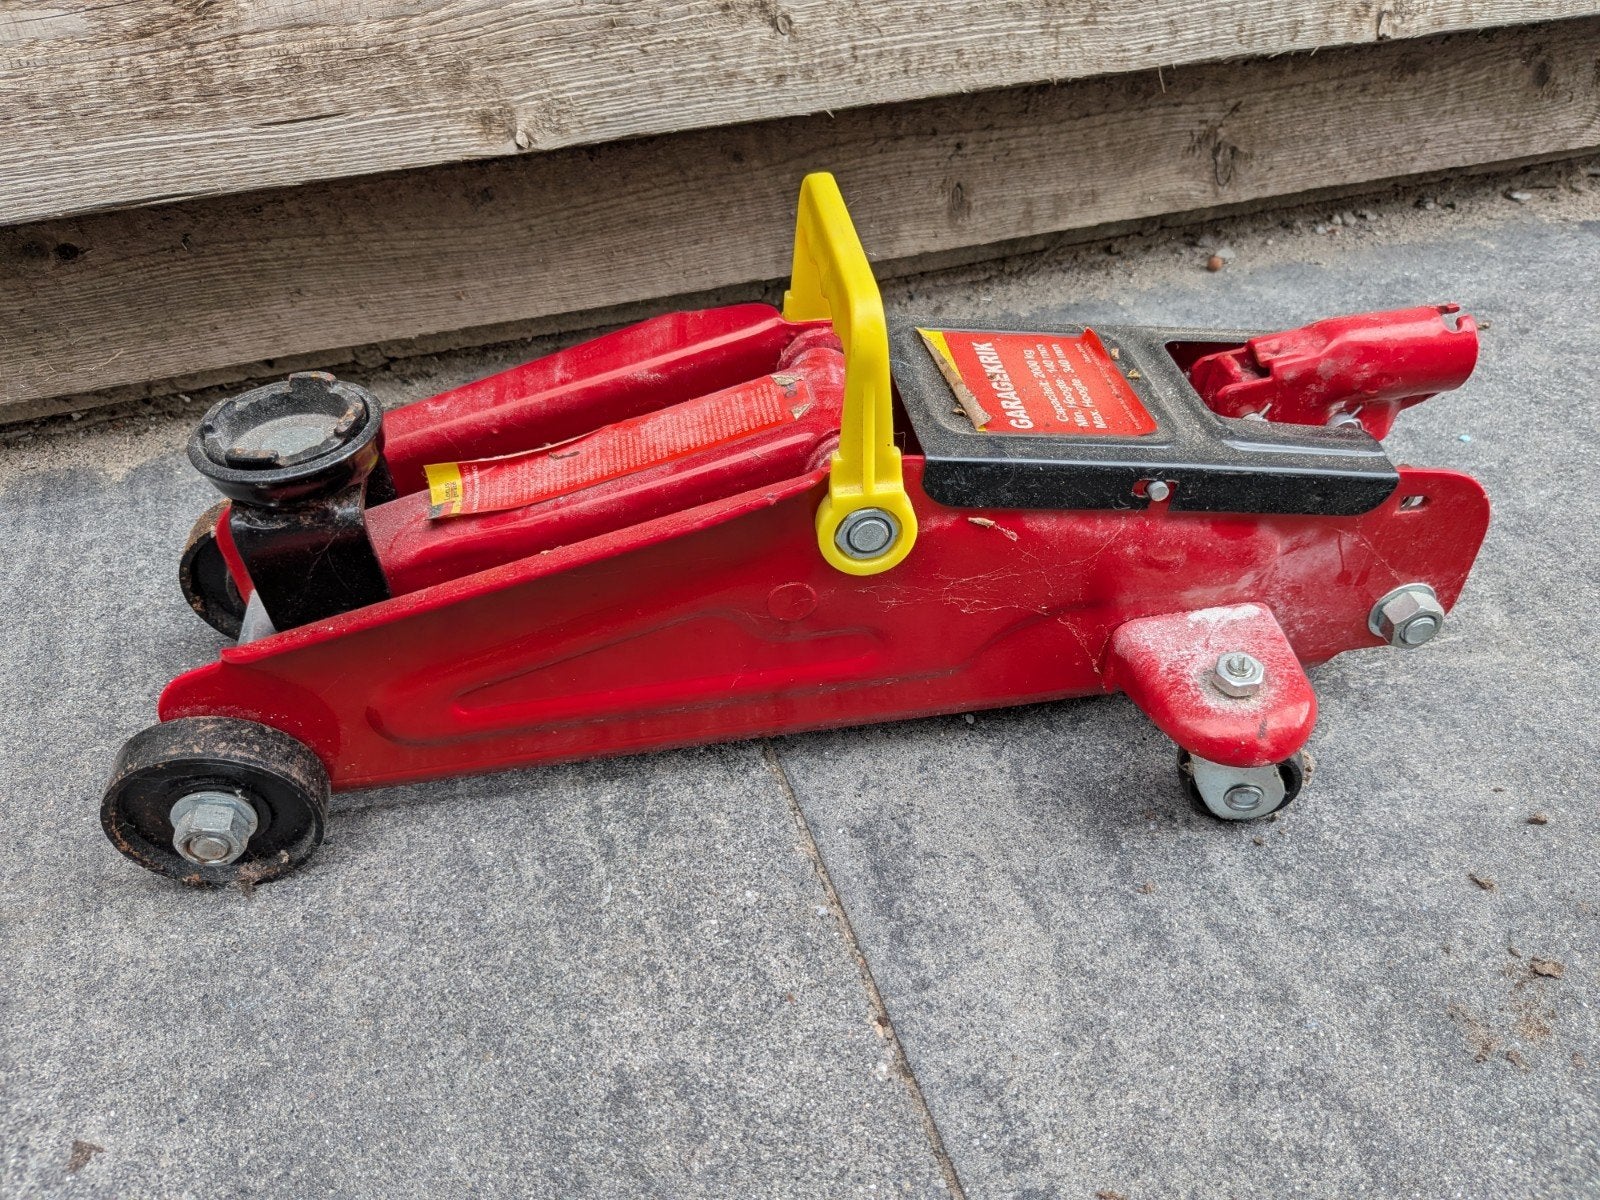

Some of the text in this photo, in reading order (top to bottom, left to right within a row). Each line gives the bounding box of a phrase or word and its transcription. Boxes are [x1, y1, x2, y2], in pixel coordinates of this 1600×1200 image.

[1022, 349, 1036, 359] kg
[1034, 343, 1051, 358] mm
[1050, 343, 1067, 358] mm
[1027, 359, 1046, 378] 2000
[1042, 358, 1059, 373] 140
[1058, 358, 1076, 373] 340
[971, 341, 1035, 429] GARAGEKRIK
[1070, 378, 1095, 408] Hoogte
[1070, 409, 1090, 427] Min.
[1088, 409, 1108, 429] Max.
